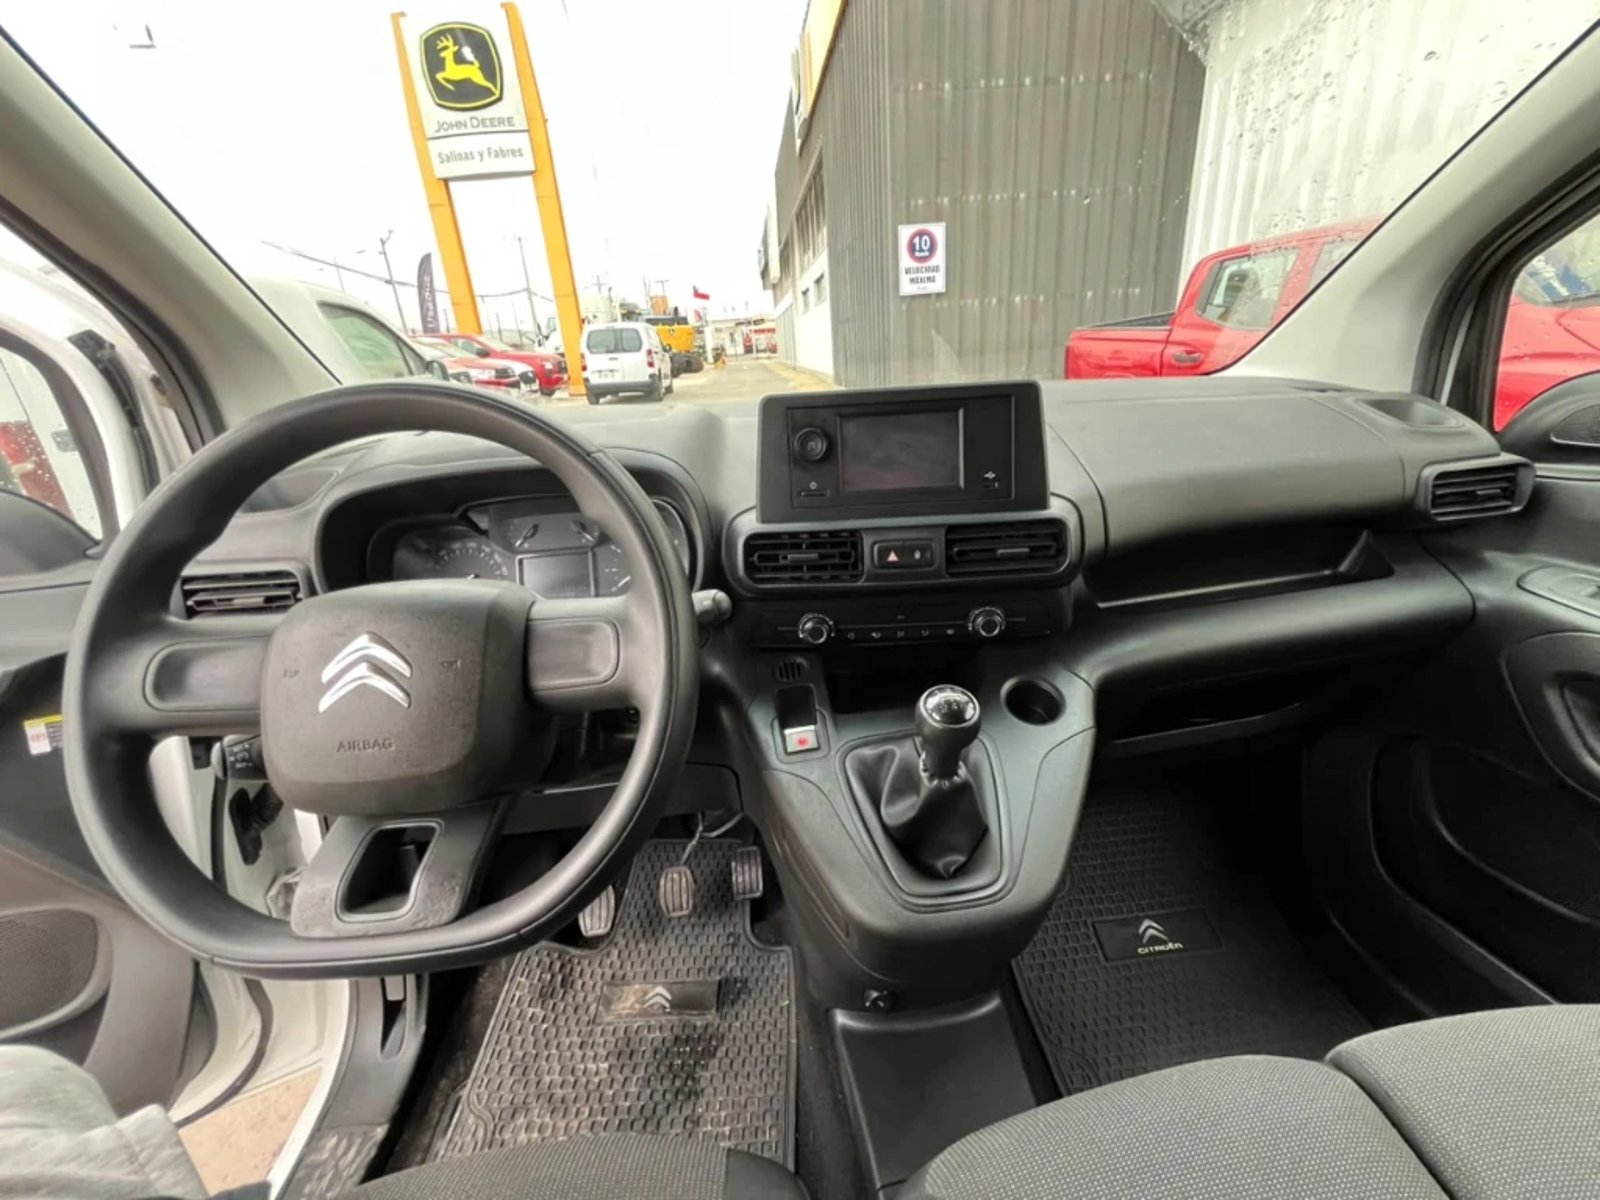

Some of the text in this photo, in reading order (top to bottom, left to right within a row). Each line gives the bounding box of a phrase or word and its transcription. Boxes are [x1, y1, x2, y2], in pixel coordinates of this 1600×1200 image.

[434, 116, 516, 133] JOHN DEERE
[437, 146, 524, 164] Salinas y Fabres
[912, 234, 931, 251] 10
[336, 737, 395, 753] AIRBAG
